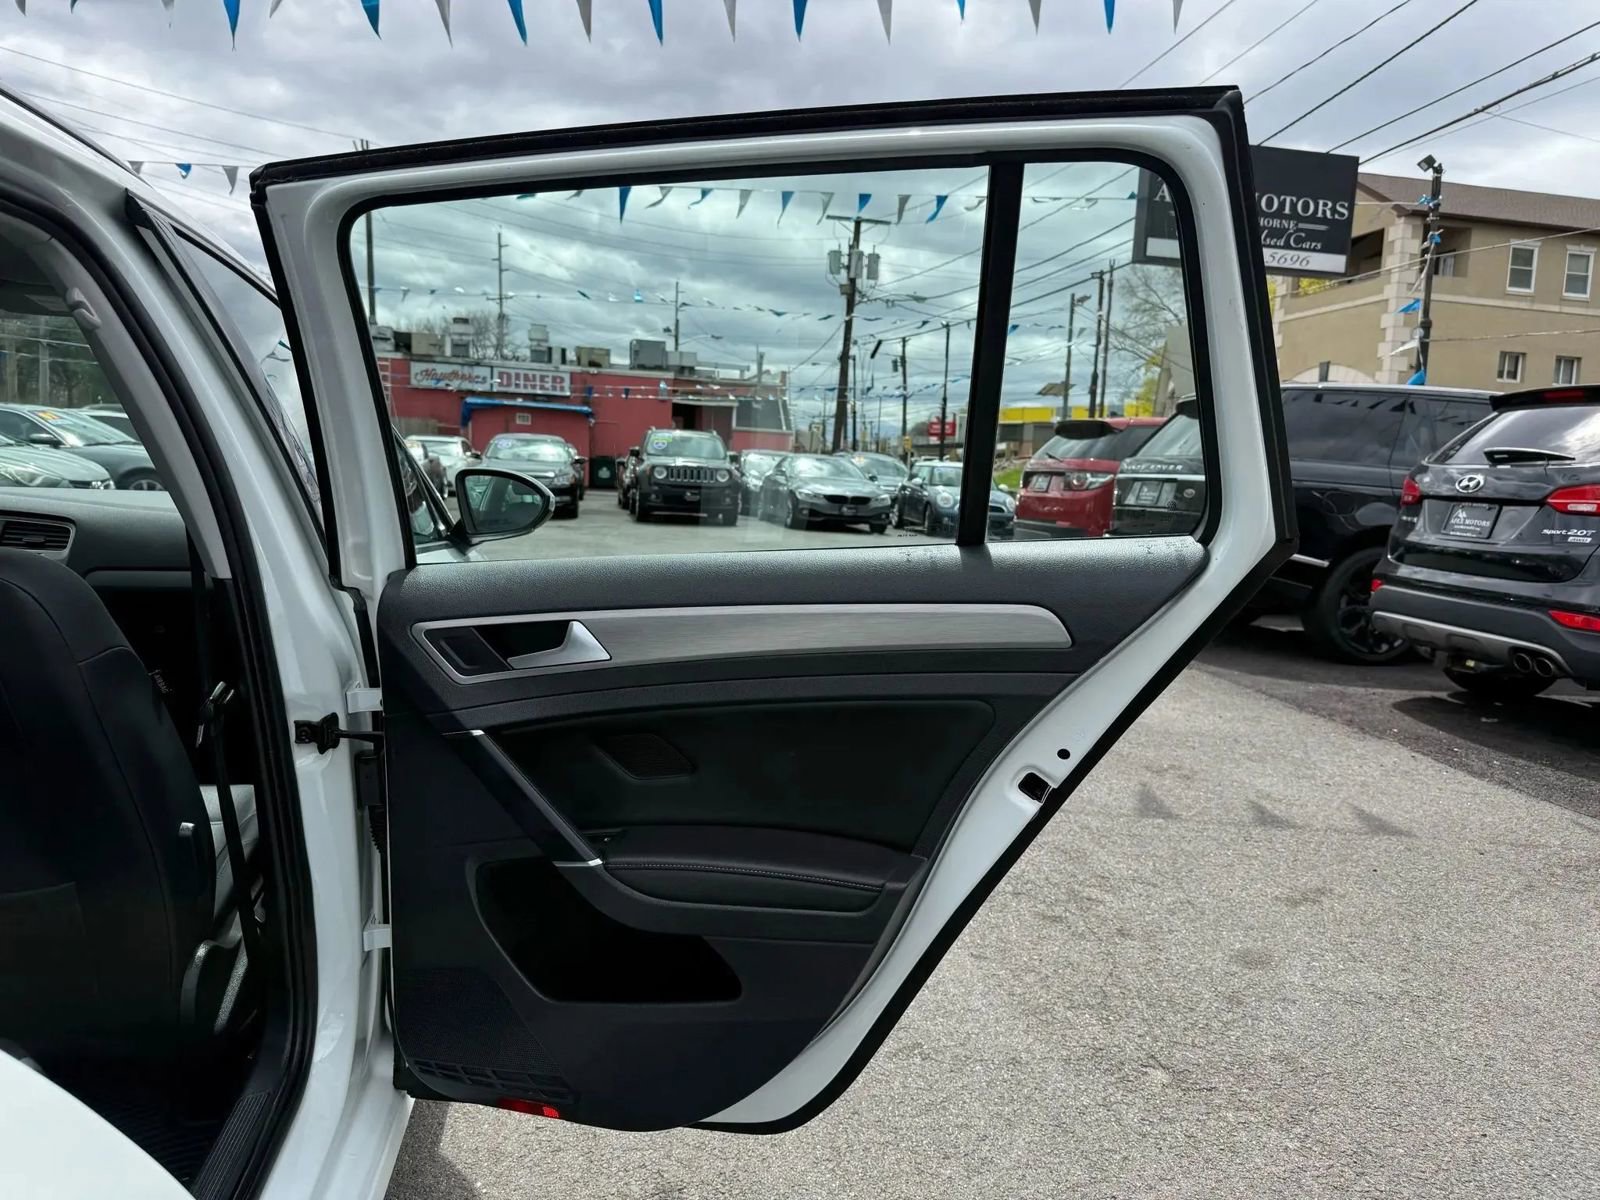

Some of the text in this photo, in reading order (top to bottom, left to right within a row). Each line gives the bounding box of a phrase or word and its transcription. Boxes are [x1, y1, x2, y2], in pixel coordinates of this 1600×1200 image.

[1256, 192, 1349, 220] OTORS
[1289, 232, 1322, 250] Cars
[1266, 252, 1311, 268] 5696
[498, 371, 565, 392] DINER
